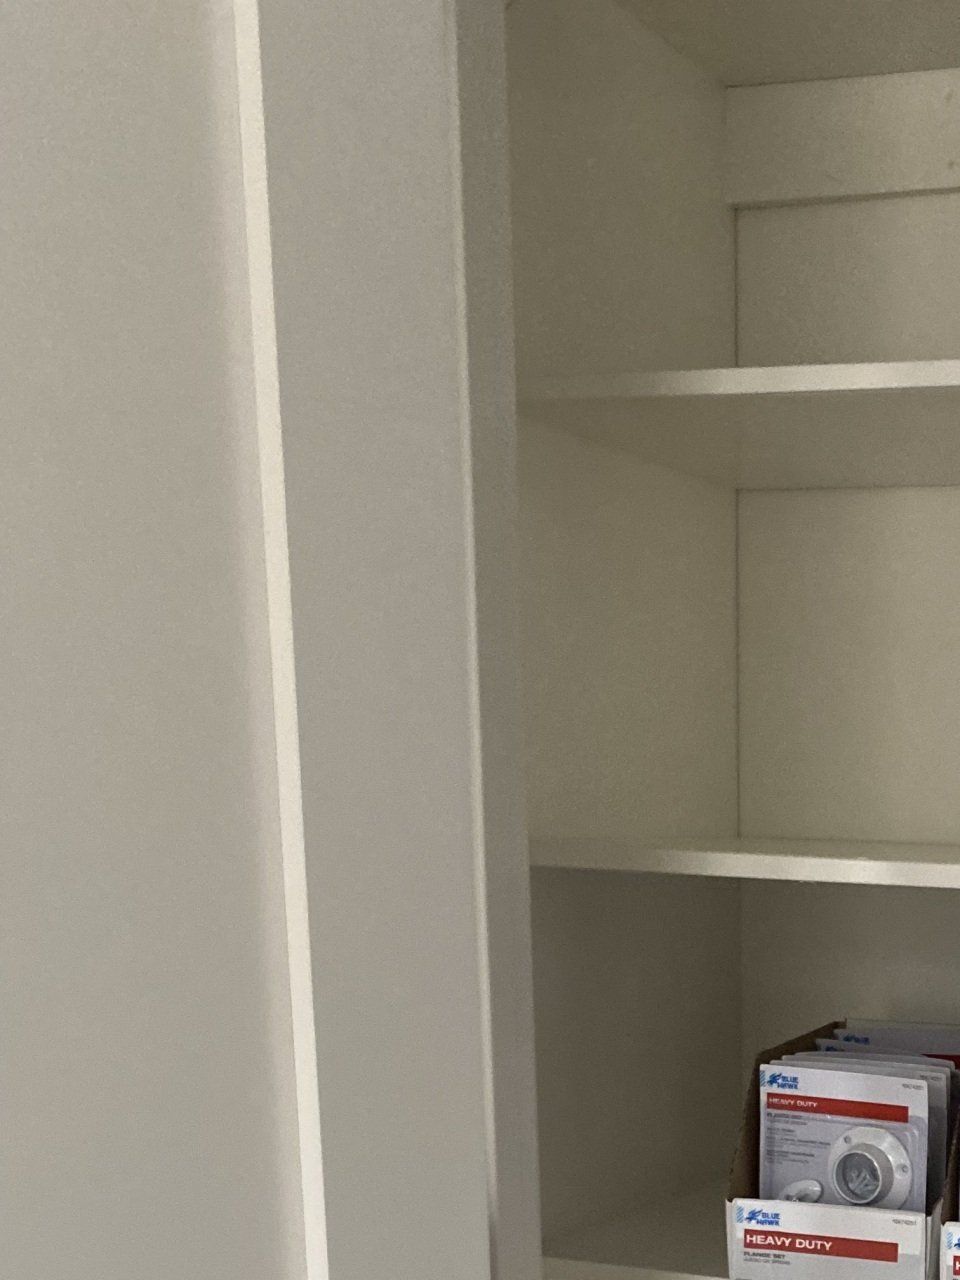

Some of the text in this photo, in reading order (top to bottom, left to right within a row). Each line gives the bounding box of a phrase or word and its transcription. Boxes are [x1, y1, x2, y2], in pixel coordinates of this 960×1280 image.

[769, 1098, 818, 1108] HEAVY DUTY
[746, 1234, 833, 1251] HEAVY DUTY
